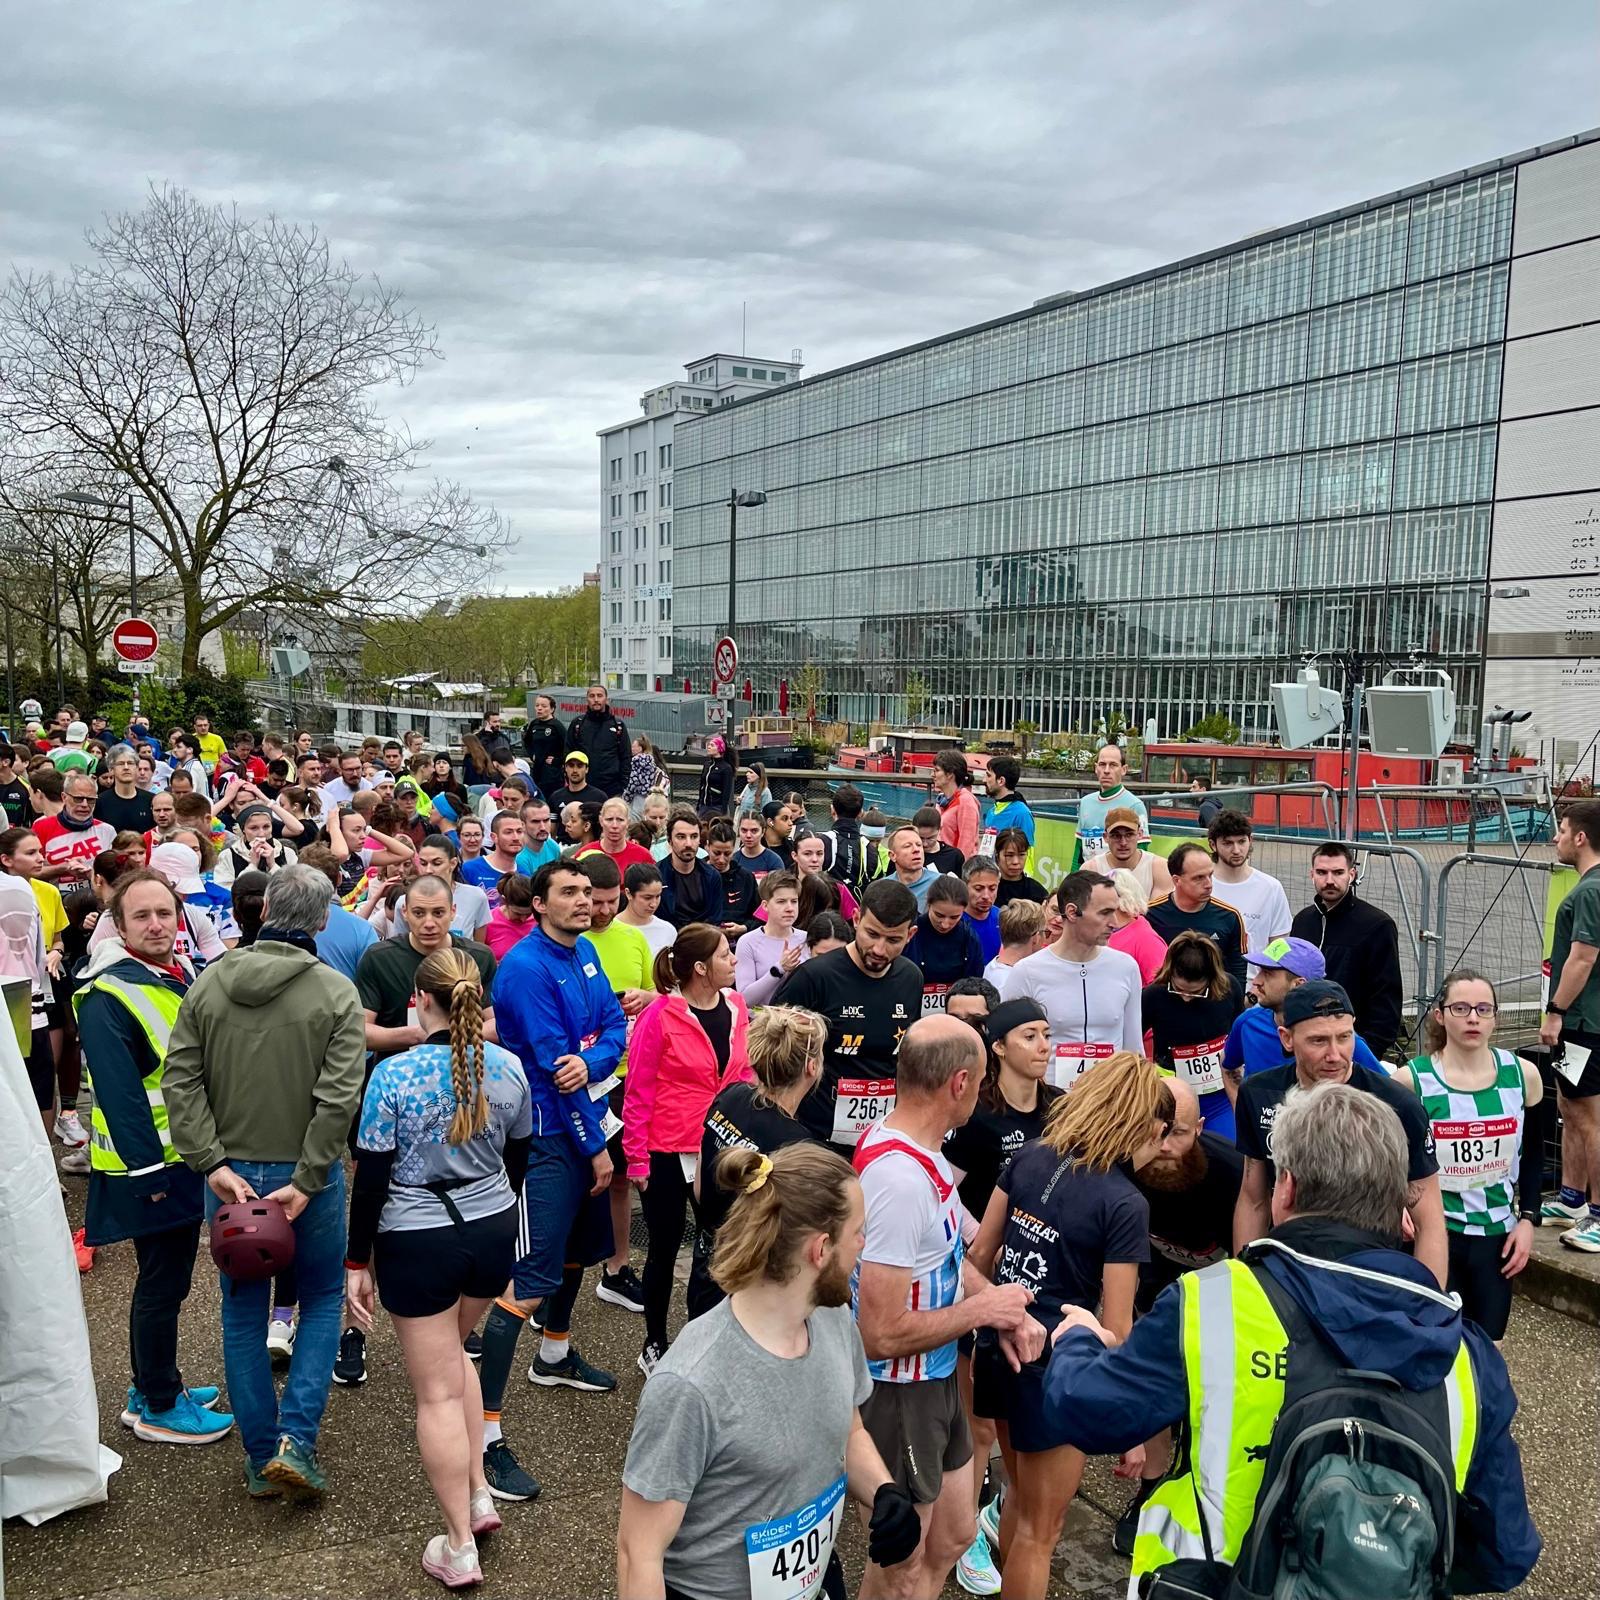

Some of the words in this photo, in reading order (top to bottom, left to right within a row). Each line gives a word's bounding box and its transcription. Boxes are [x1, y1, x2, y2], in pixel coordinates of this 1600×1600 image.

[470, 1101, 515, 1110] TTHLON
[847, 1097, 889, 1120] 256-1
[1450, 1137, 1501, 1163] 183-1
[1444, 1164, 1481, 1175] VIRGINIE
[1483, 1159, 1508, 1171] MARIE
[751, 1522, 792, 1540] EKIDEN
[798, 1508, 817, 1528] AGIPI
[772, 1511, 835, 1582] 420-1
[1353, 1535, 1389, 1552] deuter
[800, 1565, 821, 1589] TOM
